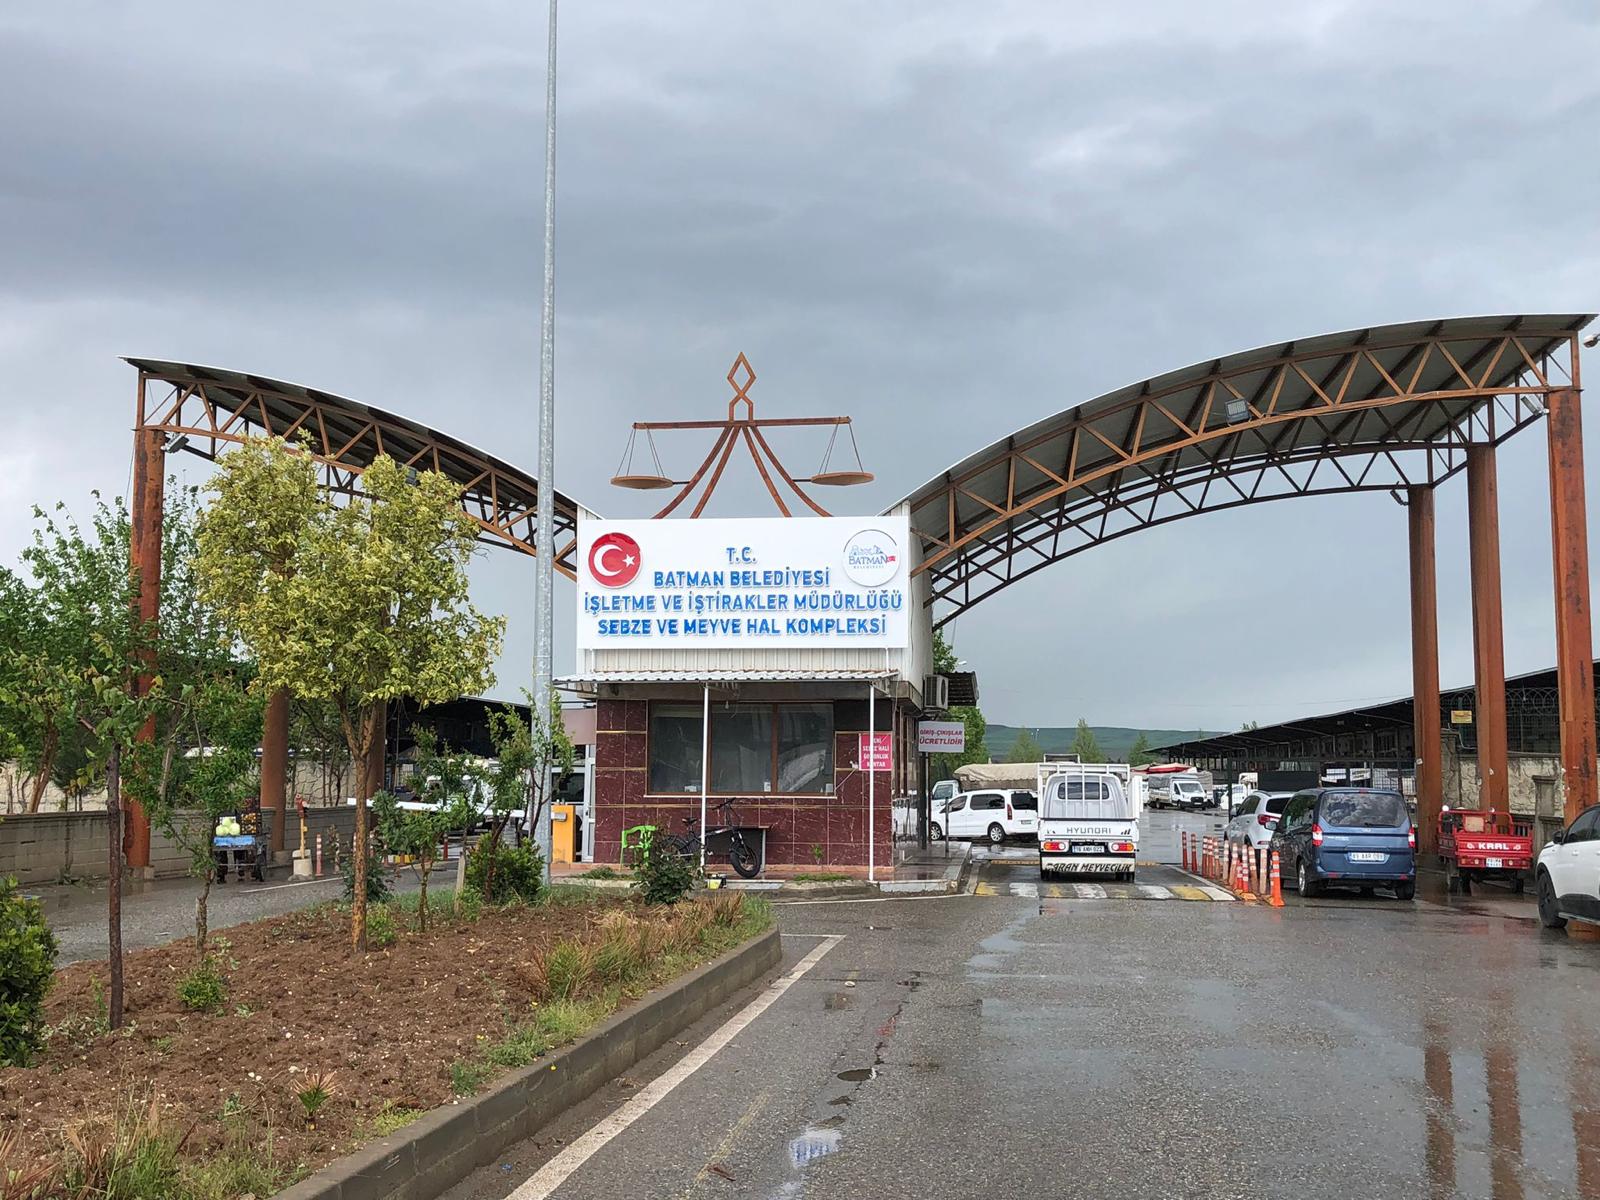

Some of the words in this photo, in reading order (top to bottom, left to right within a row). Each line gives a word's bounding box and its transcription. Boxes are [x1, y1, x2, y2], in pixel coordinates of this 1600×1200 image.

[726, 546, 757, 563] T.C.
[849, 555, 888, 565] BATMAN
[654, 570, 724, 587] BATMAN
[730, 566, 830, 587] BELEDİYESİ
[584, 591, 656, 615] İŞLETME
[661, 594, 683, 611] VE
[688, 590, 789, 615] İŞTİRAKLER
[794, 589, 902, 611] MÜDÜRLÜĞÜ
[597, 619, 652, 635] SEBZE
[656, 618, 679, 635] VE
[683, 618, 742, 635] MEYVE
[746, 618, 781, 635] HAL
[786, 613, 887, 635] KOMPLEKSİ
